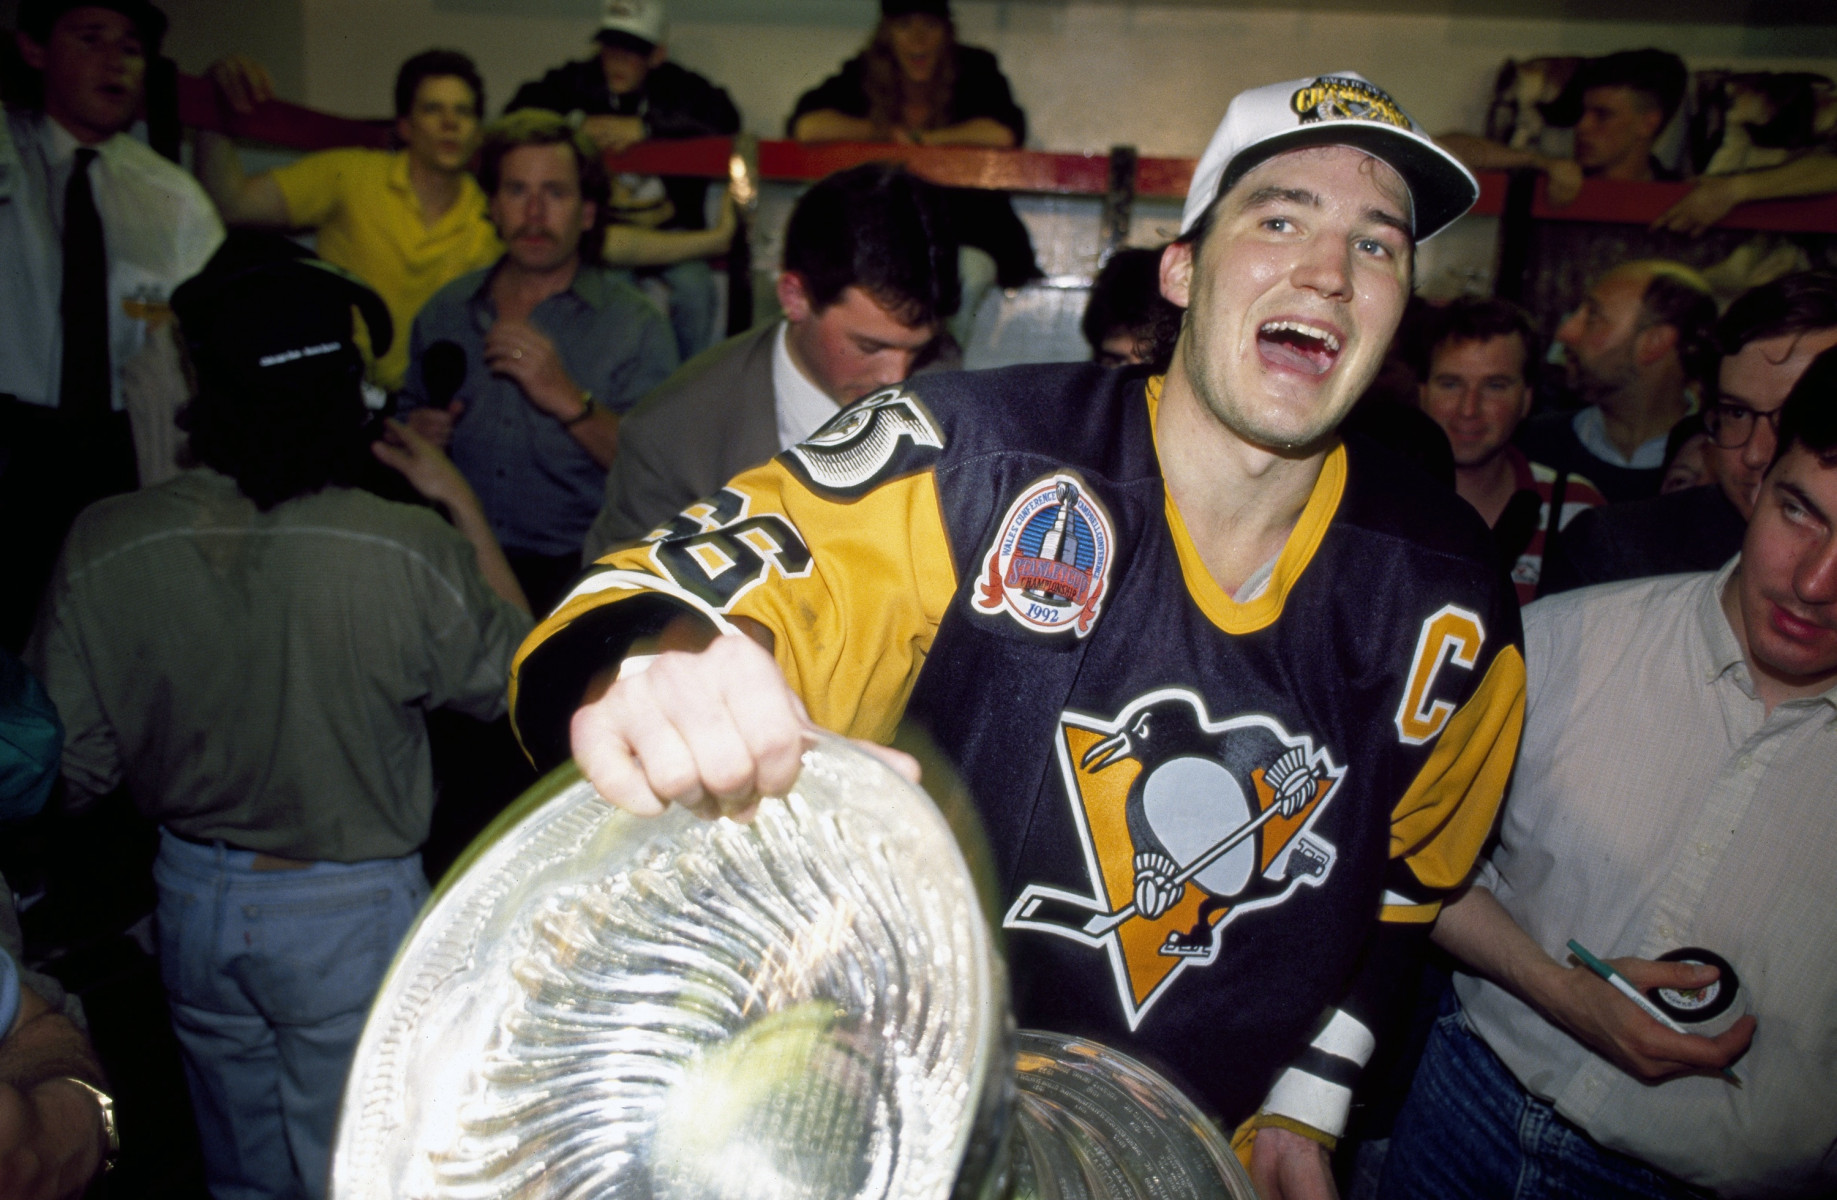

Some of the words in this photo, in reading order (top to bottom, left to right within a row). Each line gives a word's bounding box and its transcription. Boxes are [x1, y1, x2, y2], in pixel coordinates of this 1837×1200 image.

[1001, 525, 1019, 557] WALES
[1015, 490, 1057, 526] CONFERENCE
[1078, 500, 1101, 534] CAMPBELL
[1008, 557, 1069, 585] STANLEY
[1066, 568, 1089, 600] CUP
[1020, 576, 1077, 599] CHAMPIONSHIP
[1026, 603, 1059, 622] 1992
[1394, 604, 1486, 746] C
